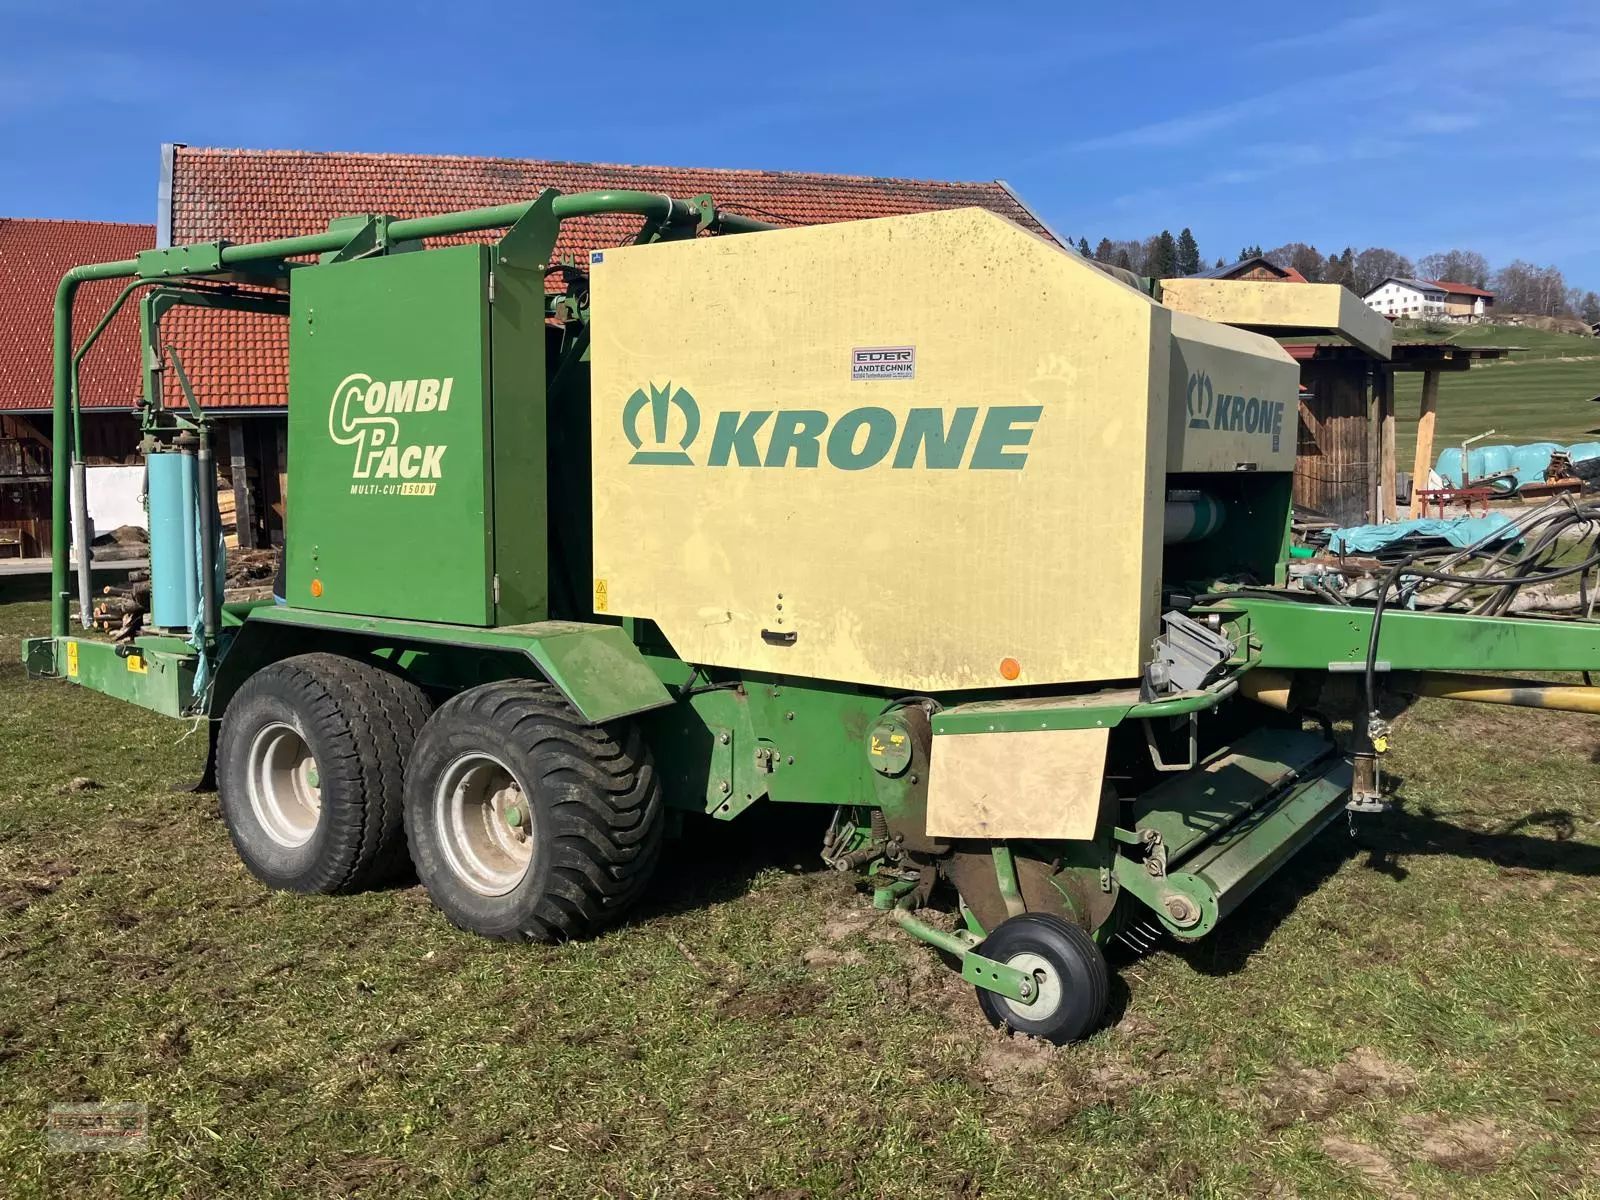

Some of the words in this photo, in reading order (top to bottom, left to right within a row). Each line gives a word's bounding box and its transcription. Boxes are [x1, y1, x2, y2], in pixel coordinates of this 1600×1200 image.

[853, 364, 912, 372] LANDTECHNIK
[857, 352, 911, 361] EDER
[329, 373, 454, 445] COMBI
[1214, 394, 1285, 435] KRONE
[352, 416, 448, 479] PACK
[706, 405, 1044, 471] KRONE
[350, 484, 402, 495] MULTI-CUT
[403, 484, 426, 494] 1500
[428, 484, 435, 494] V
